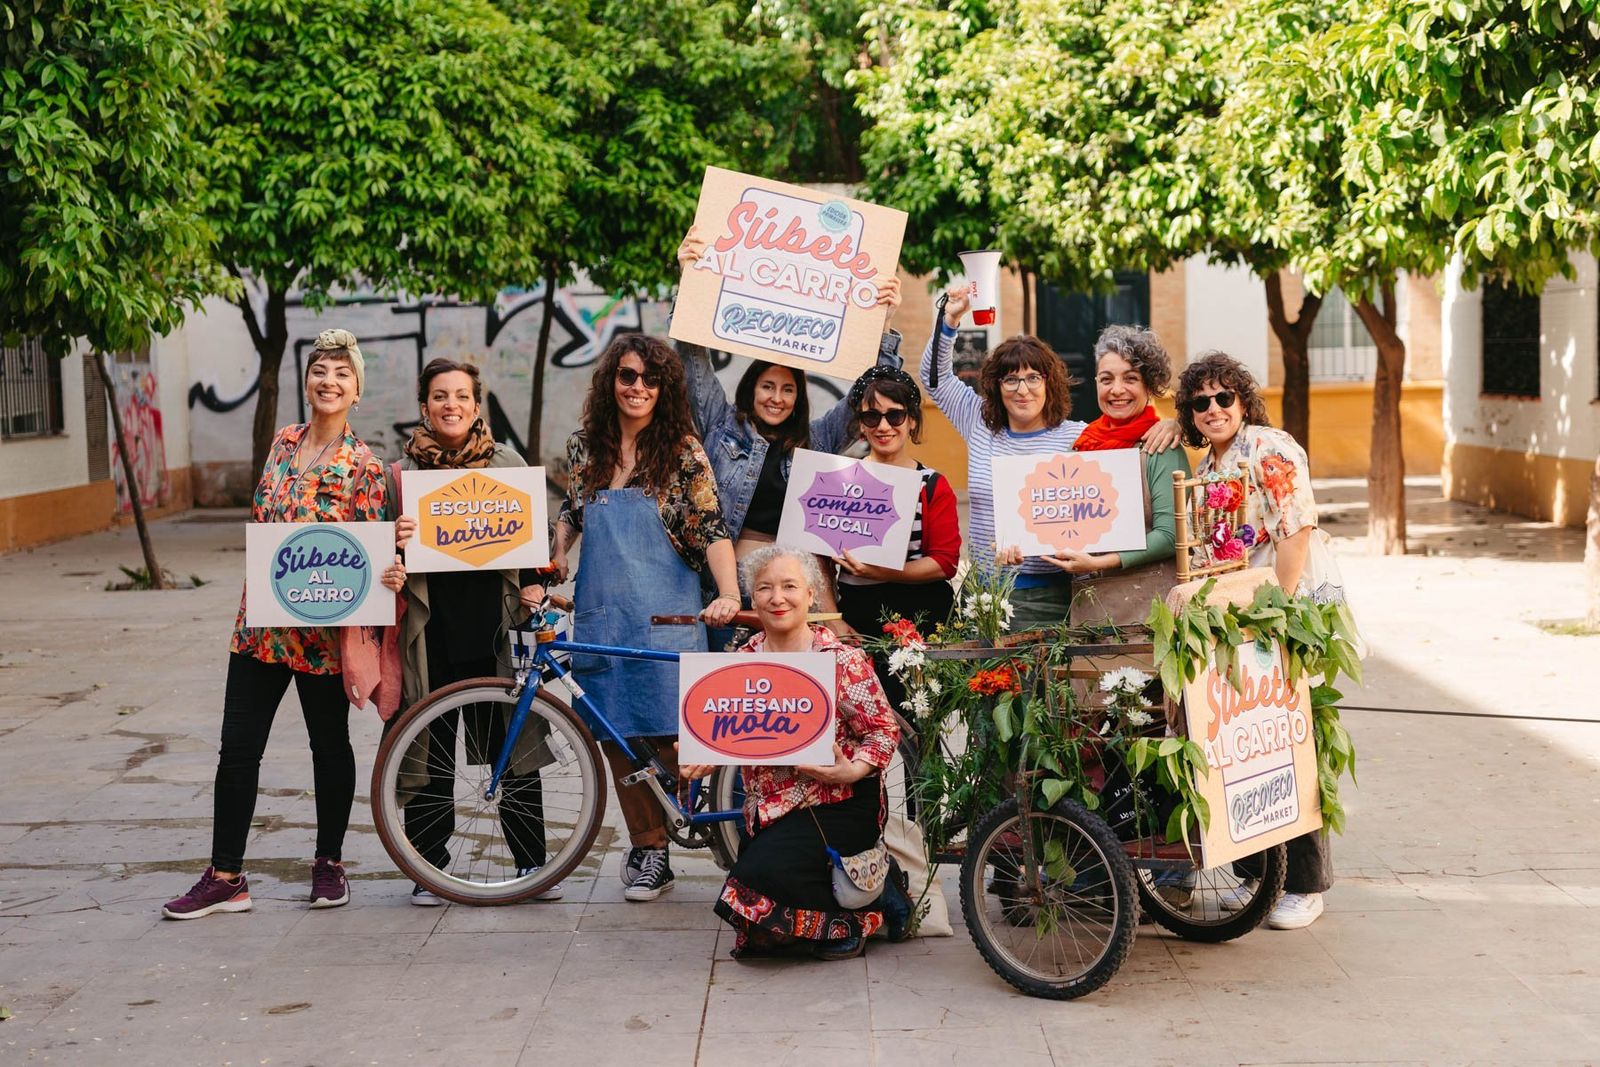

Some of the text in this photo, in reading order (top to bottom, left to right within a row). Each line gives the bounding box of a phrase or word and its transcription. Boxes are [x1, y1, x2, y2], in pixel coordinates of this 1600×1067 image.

[714, 201, 878, 280] Súbete
[693, 244, 881, 310] AL CARRO
[721, 303, 836, 341] RECOVECO
[771, 336, 825, 355] MARKET
[842, 483, 865, 500] YO
[1030, 483, 1101, 503] HECHO
[430, 499, 523, 517] ESCUCHA
[807, 495, 893, 517] compro
[1032, 504, 1073, 521] POR
[436, 517, 525, 547] barrio
[465, 517, 489, 531] TU
[817, 514, 873, 537] LOCAL
[274, 545, 367, 581] Súbete
[308, 570, 334, 585] AL
[287, 587, 355, 603] CARRO
[745, 678, 772, 695] LO
[703, 697, 814, 714] ARTESANO
[711, 709, 800, 741] mola
[1203, 710, 1308, 770] AL CARRO
[1231, 770, 1293, 834] RECOVECO
[1263, 806, 1294, 825] MARKET
